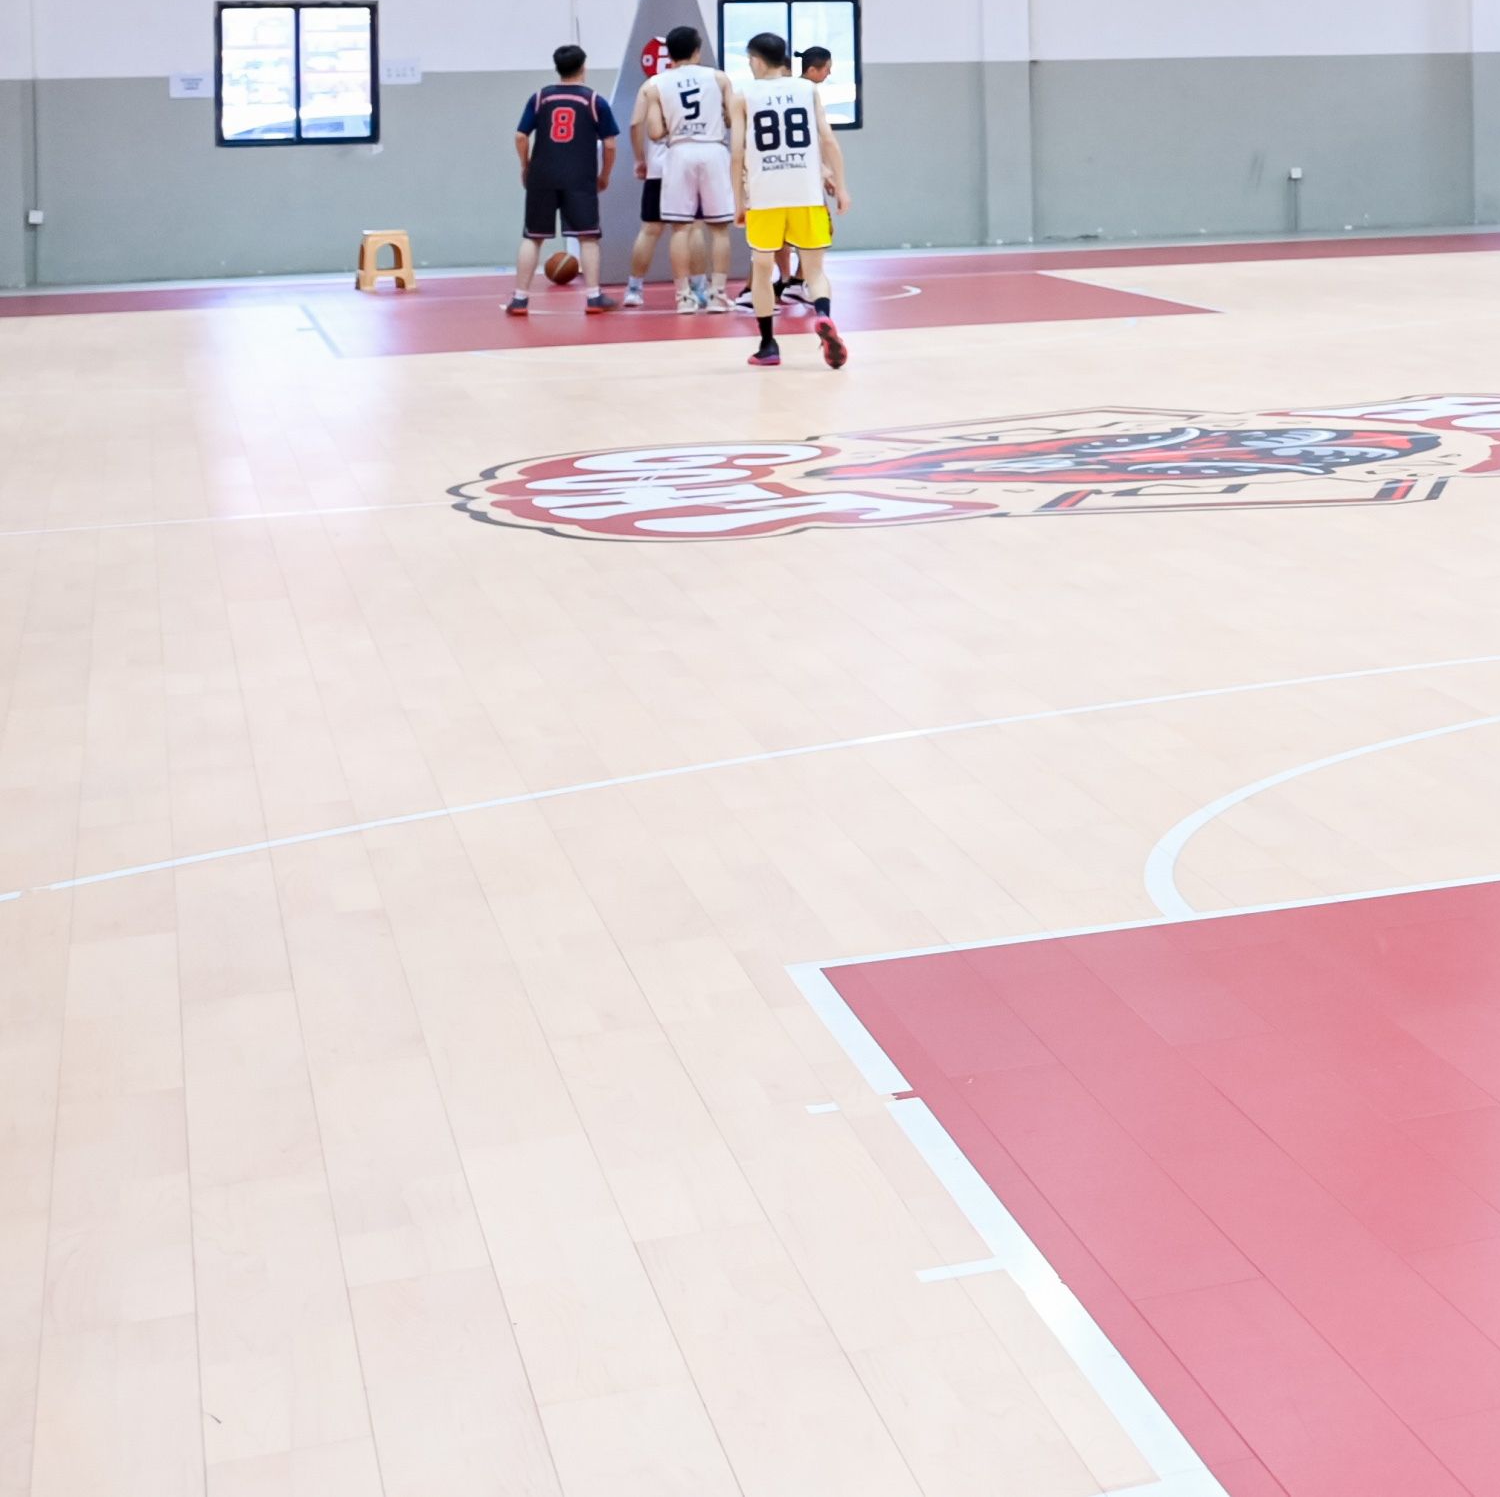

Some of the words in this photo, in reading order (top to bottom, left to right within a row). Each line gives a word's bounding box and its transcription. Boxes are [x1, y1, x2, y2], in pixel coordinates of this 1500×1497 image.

[680, 88, 701, 121] 5
[550, 106, 576, 143] 8
[753, 107, 812, 152] 88
